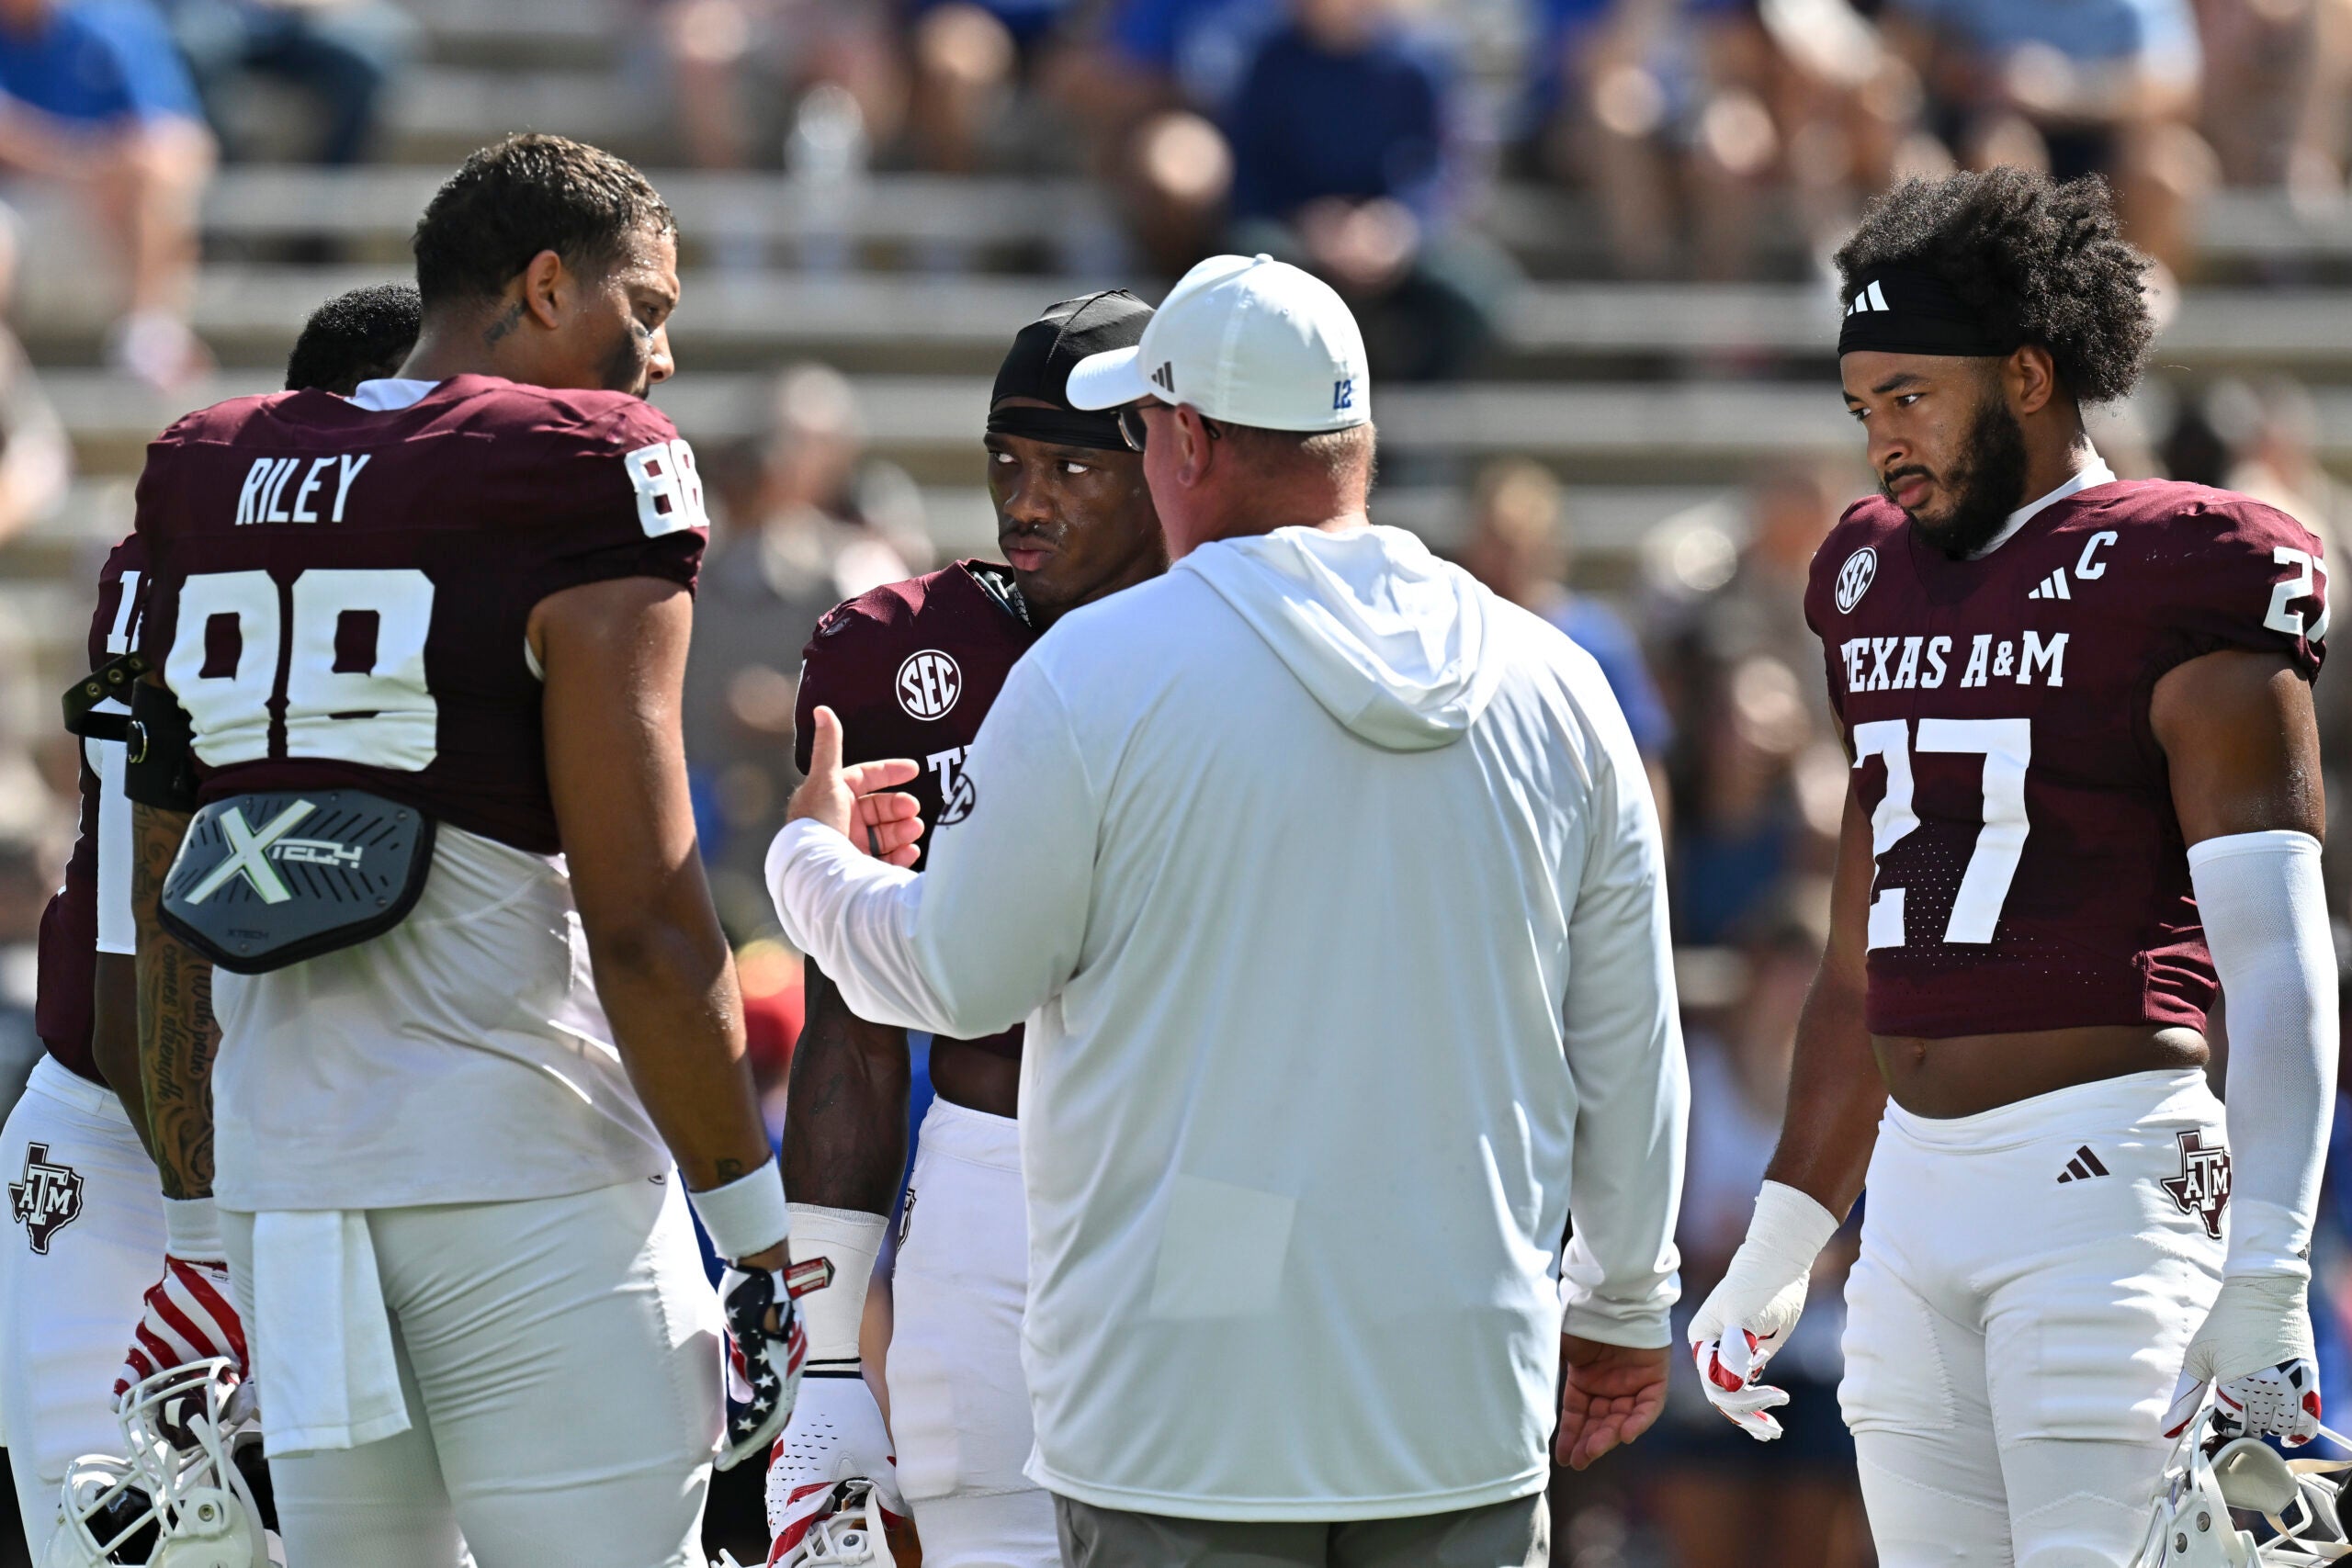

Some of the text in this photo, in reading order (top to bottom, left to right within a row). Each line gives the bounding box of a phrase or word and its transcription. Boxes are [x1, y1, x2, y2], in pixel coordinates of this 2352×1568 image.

[1333, 379, 1352, 410] 12
[235, 454, 371, 525] RILEY
[625, 439, 710, 538] 88
[1838, 551, 1874, 609] SEC
[2075, 531, 2118, 580] C
[2263, 546, 2330, 643] 27
[901, 655, 956, 716] SEC
[1961, 630, 2070, 687] A&M
[1852, 718, 2031, 956] 27
[162, 944, 180, 1008] comes
